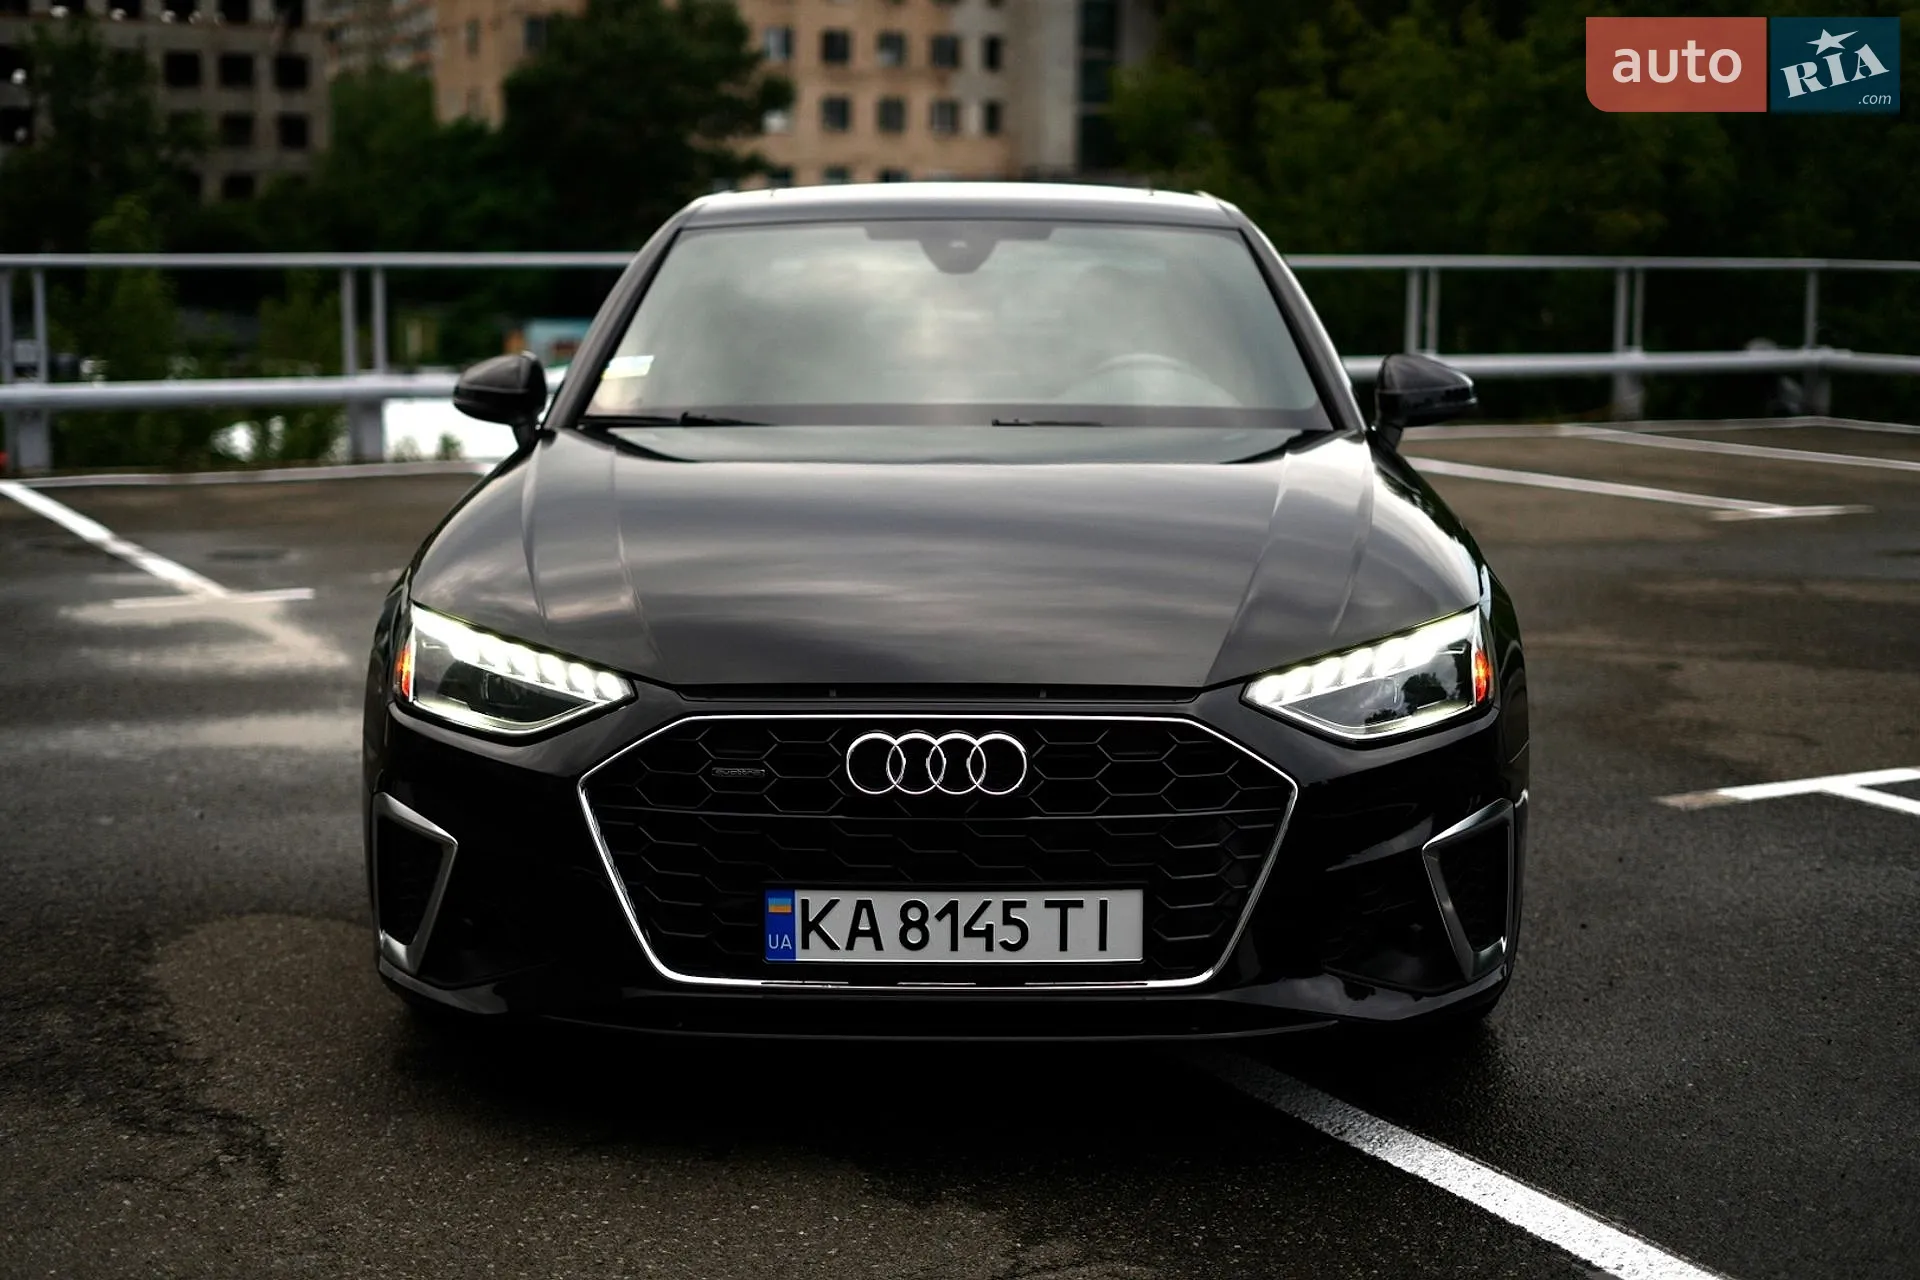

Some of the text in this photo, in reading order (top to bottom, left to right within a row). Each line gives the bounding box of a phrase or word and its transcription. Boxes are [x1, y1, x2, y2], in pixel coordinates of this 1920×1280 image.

[767, 933, 793, 950] UA
[800, 898, 1109, 953] KA 8145 TI
